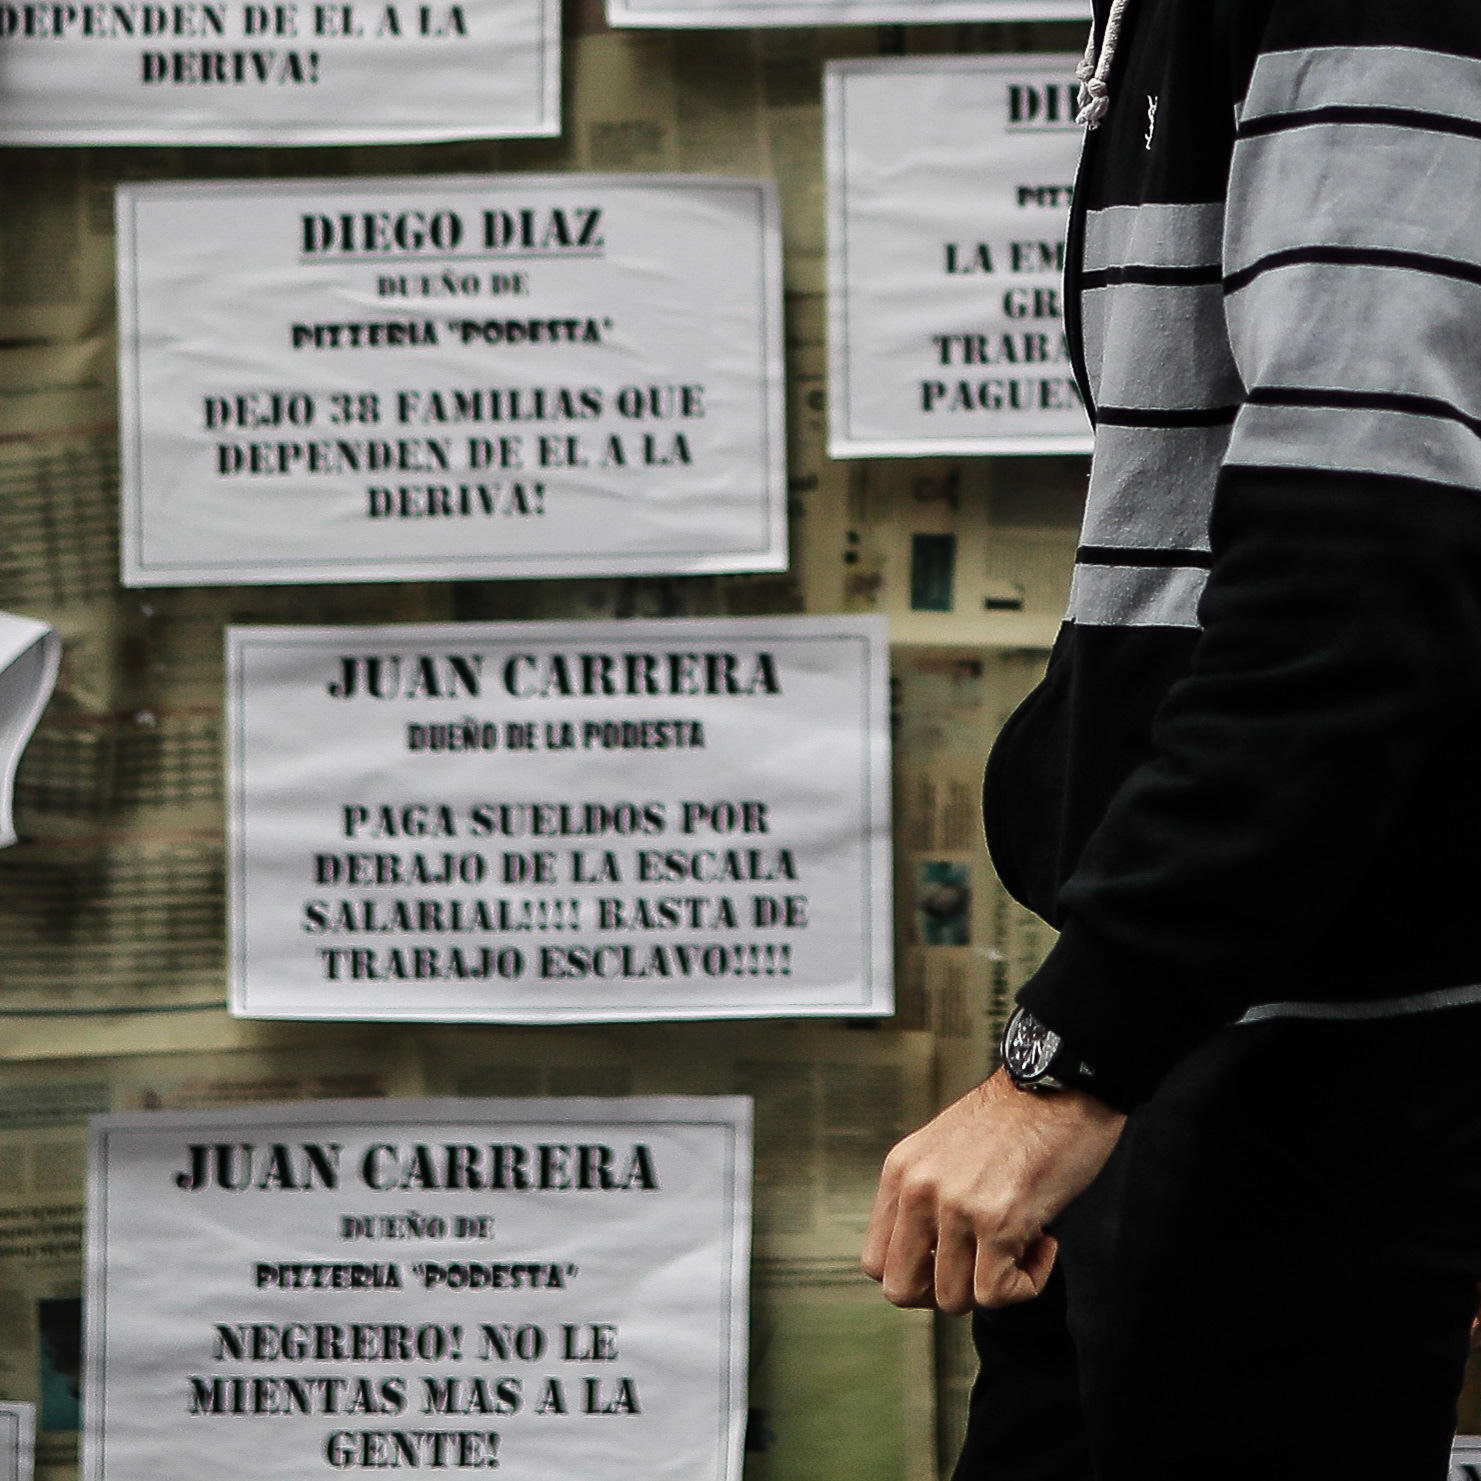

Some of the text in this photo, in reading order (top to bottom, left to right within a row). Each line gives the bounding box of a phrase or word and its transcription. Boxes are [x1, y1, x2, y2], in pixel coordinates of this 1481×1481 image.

[202, 385, 697, 431] DEJO 38 FAMILIAS QUE
[326, 651, 781, 699] JUAN CARRERA
[171, 1140, 659, 1192] JUAN CARRERA
